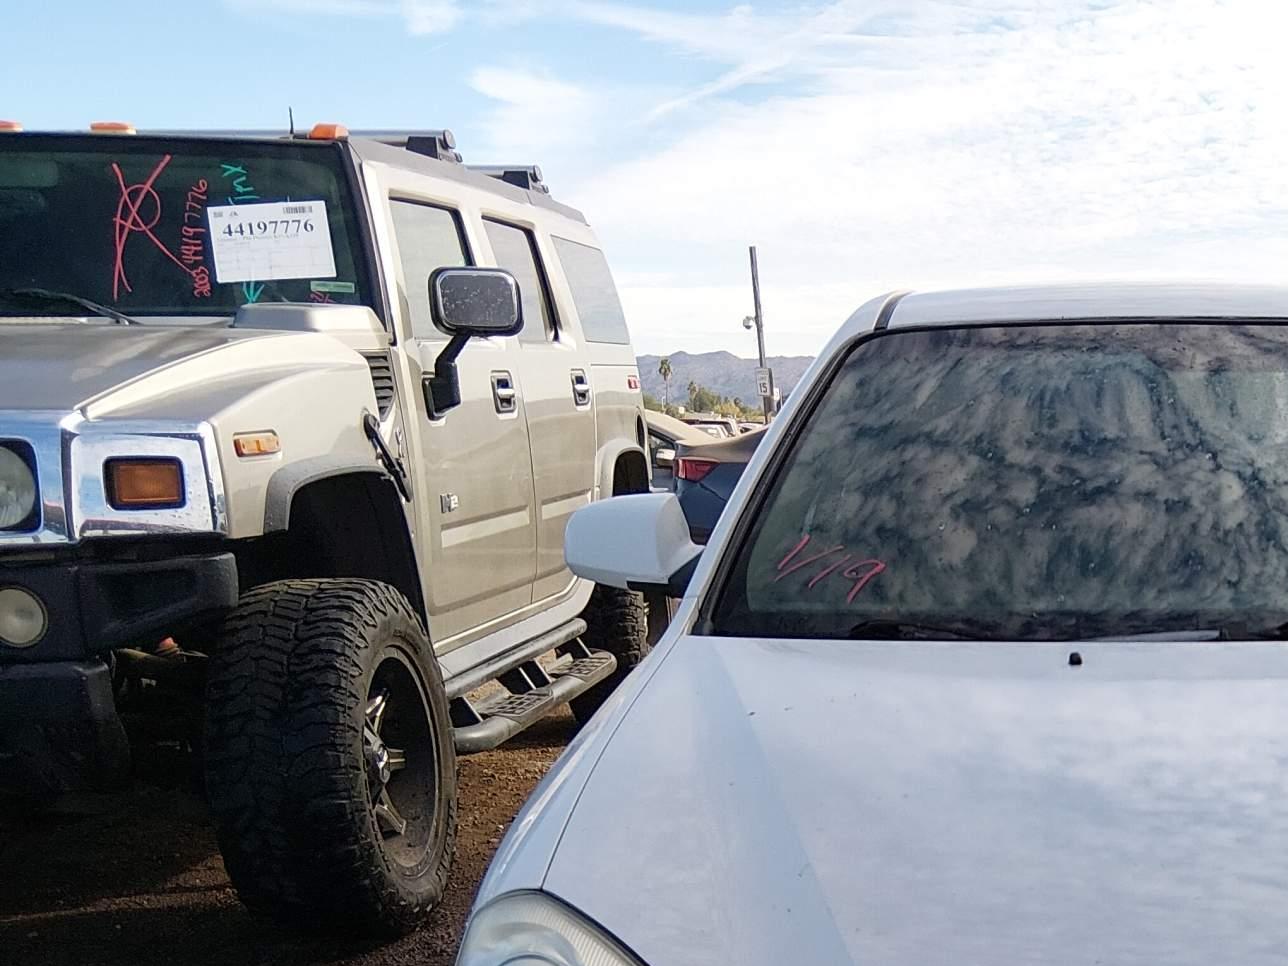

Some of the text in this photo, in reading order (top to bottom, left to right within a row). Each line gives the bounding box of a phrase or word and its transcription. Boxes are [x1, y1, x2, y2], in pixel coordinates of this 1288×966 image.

[181, 179, 208, 263] 44197776
[222, 218, 314, 237] 44197776
[759, 382, 768, 393] 15
